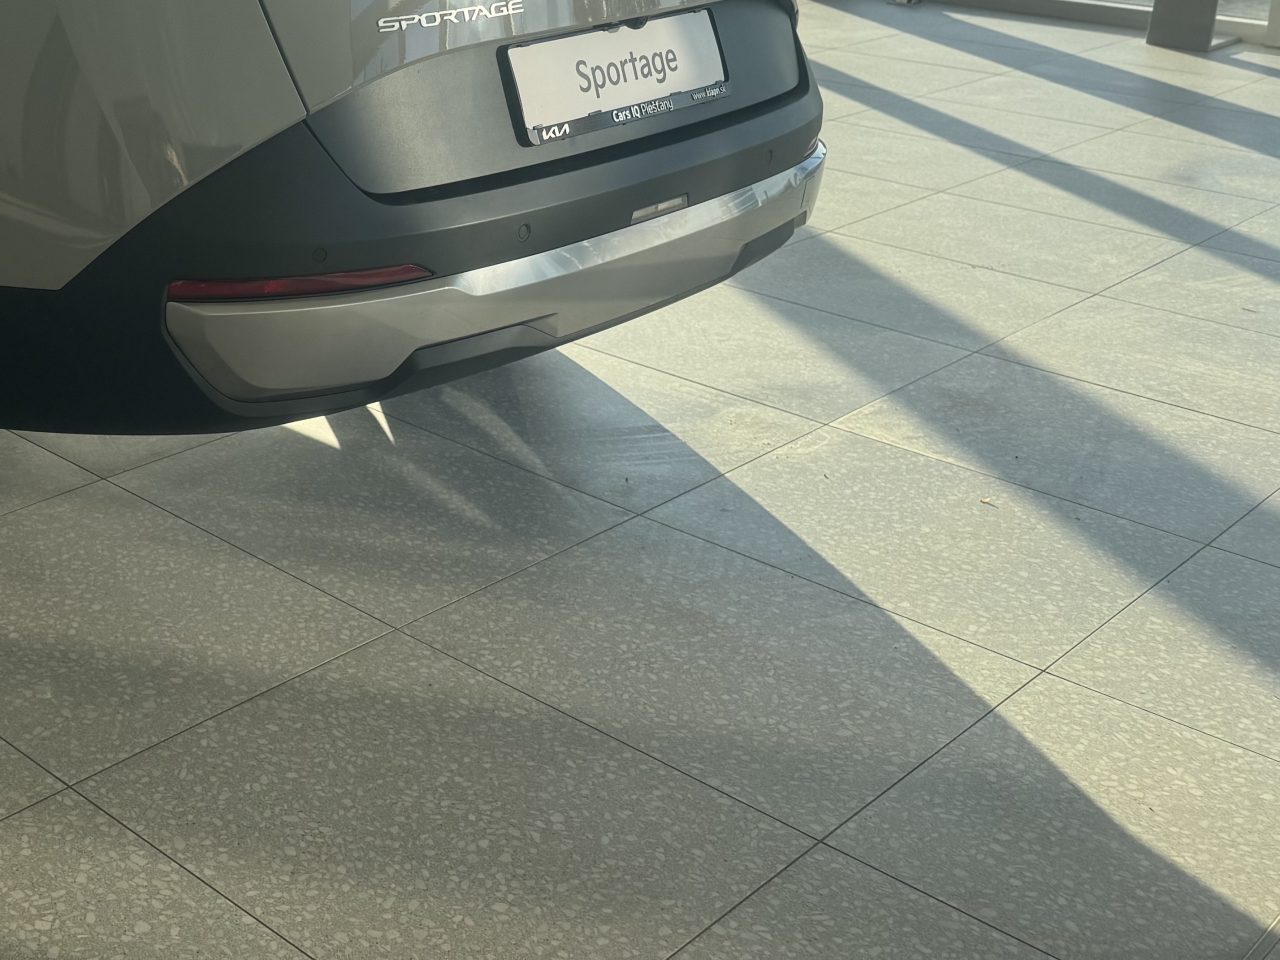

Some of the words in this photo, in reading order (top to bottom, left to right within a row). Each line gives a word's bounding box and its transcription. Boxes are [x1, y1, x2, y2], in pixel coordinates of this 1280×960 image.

[575, 48, 679, 99] Sportage
[612, 109, 631, 123] Cars
[631, 104, 641, 119] IQ
[641, 100, 674, 115] Piešťany
[542, 123, 570, 141] KIA
